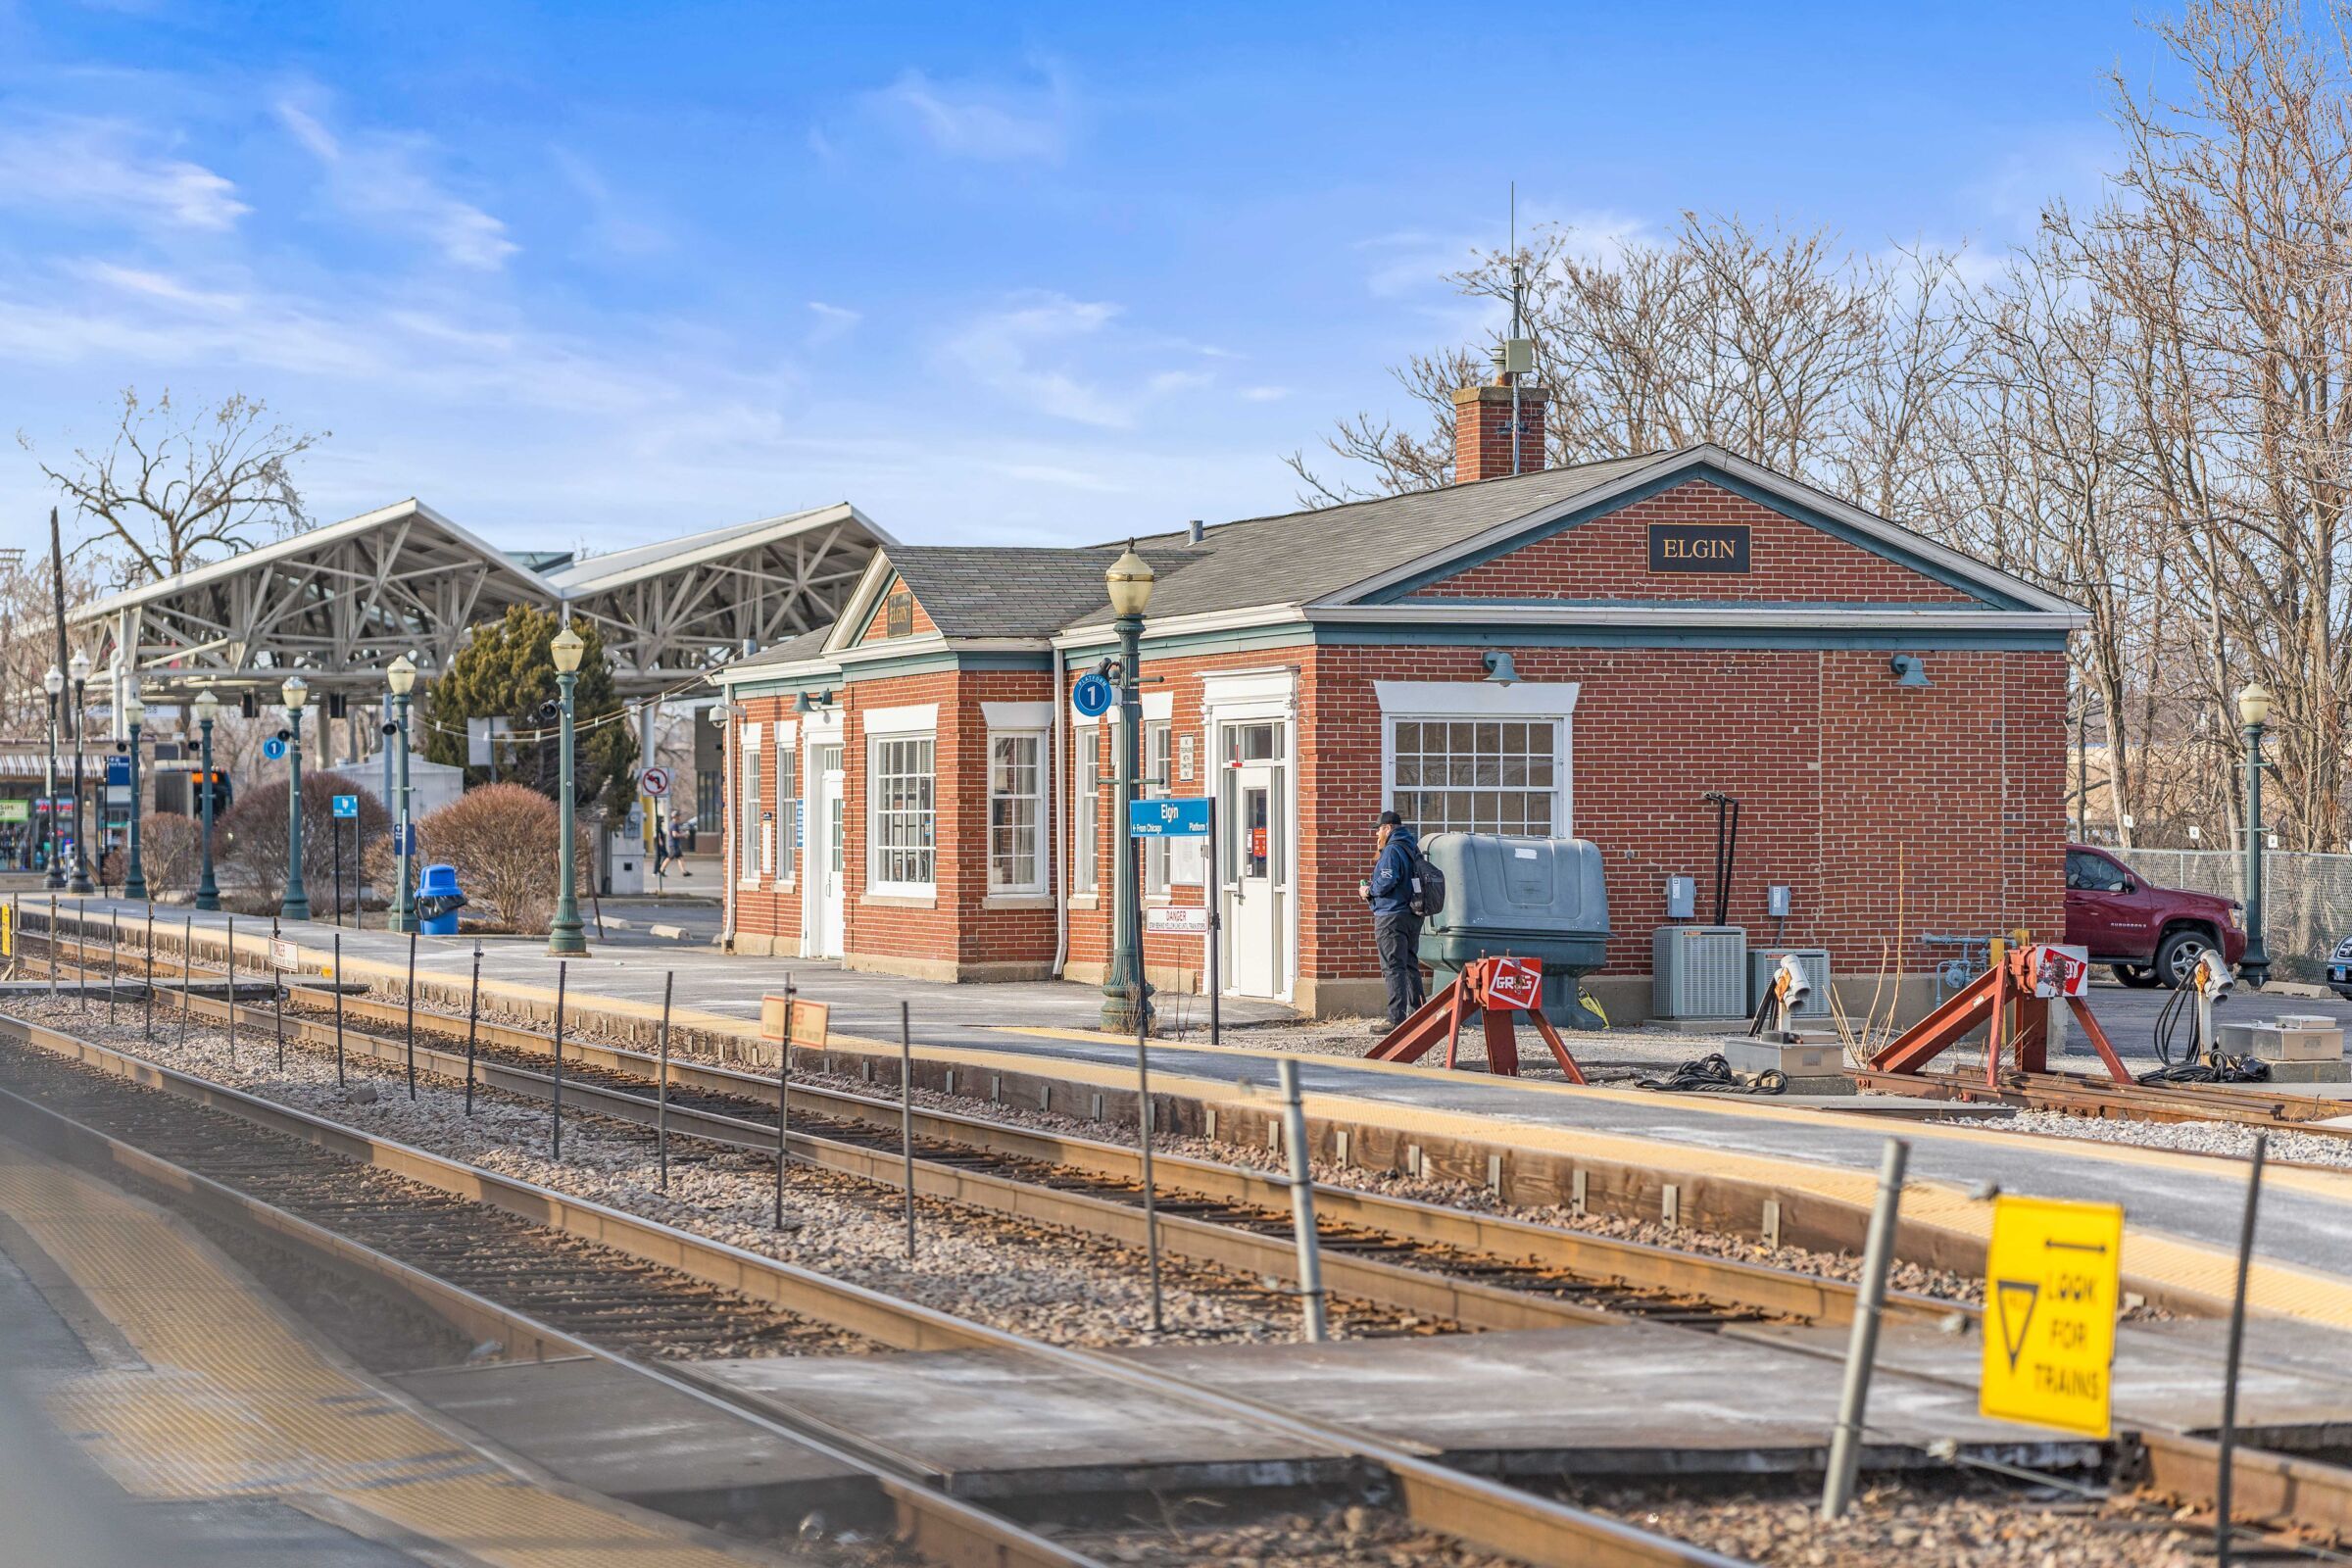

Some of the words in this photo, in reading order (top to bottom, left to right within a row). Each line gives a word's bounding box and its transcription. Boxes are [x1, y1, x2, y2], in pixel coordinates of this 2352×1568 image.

[1663, 539, 1736, 559] ELGIN
[1079, 675, 1107, 687] PLATFORM
[1088, 685, 1096, 706] 1
[270, 742, 277, 754] 1
[1160, 804, 1179, 823] Elgin
[1136, 823, 1147, 832] From
[1147, 823, 1162, 834] Chicago
[1189, 822, 1206, 832] Platform
[1166, 910, 1187, 921] DANGER
[2046, 1270, 2099, 1305] LOOK
[2049, 1317, 2088, 1350] FOR
[2034, 1362, 2101, 1401] TRAINS
